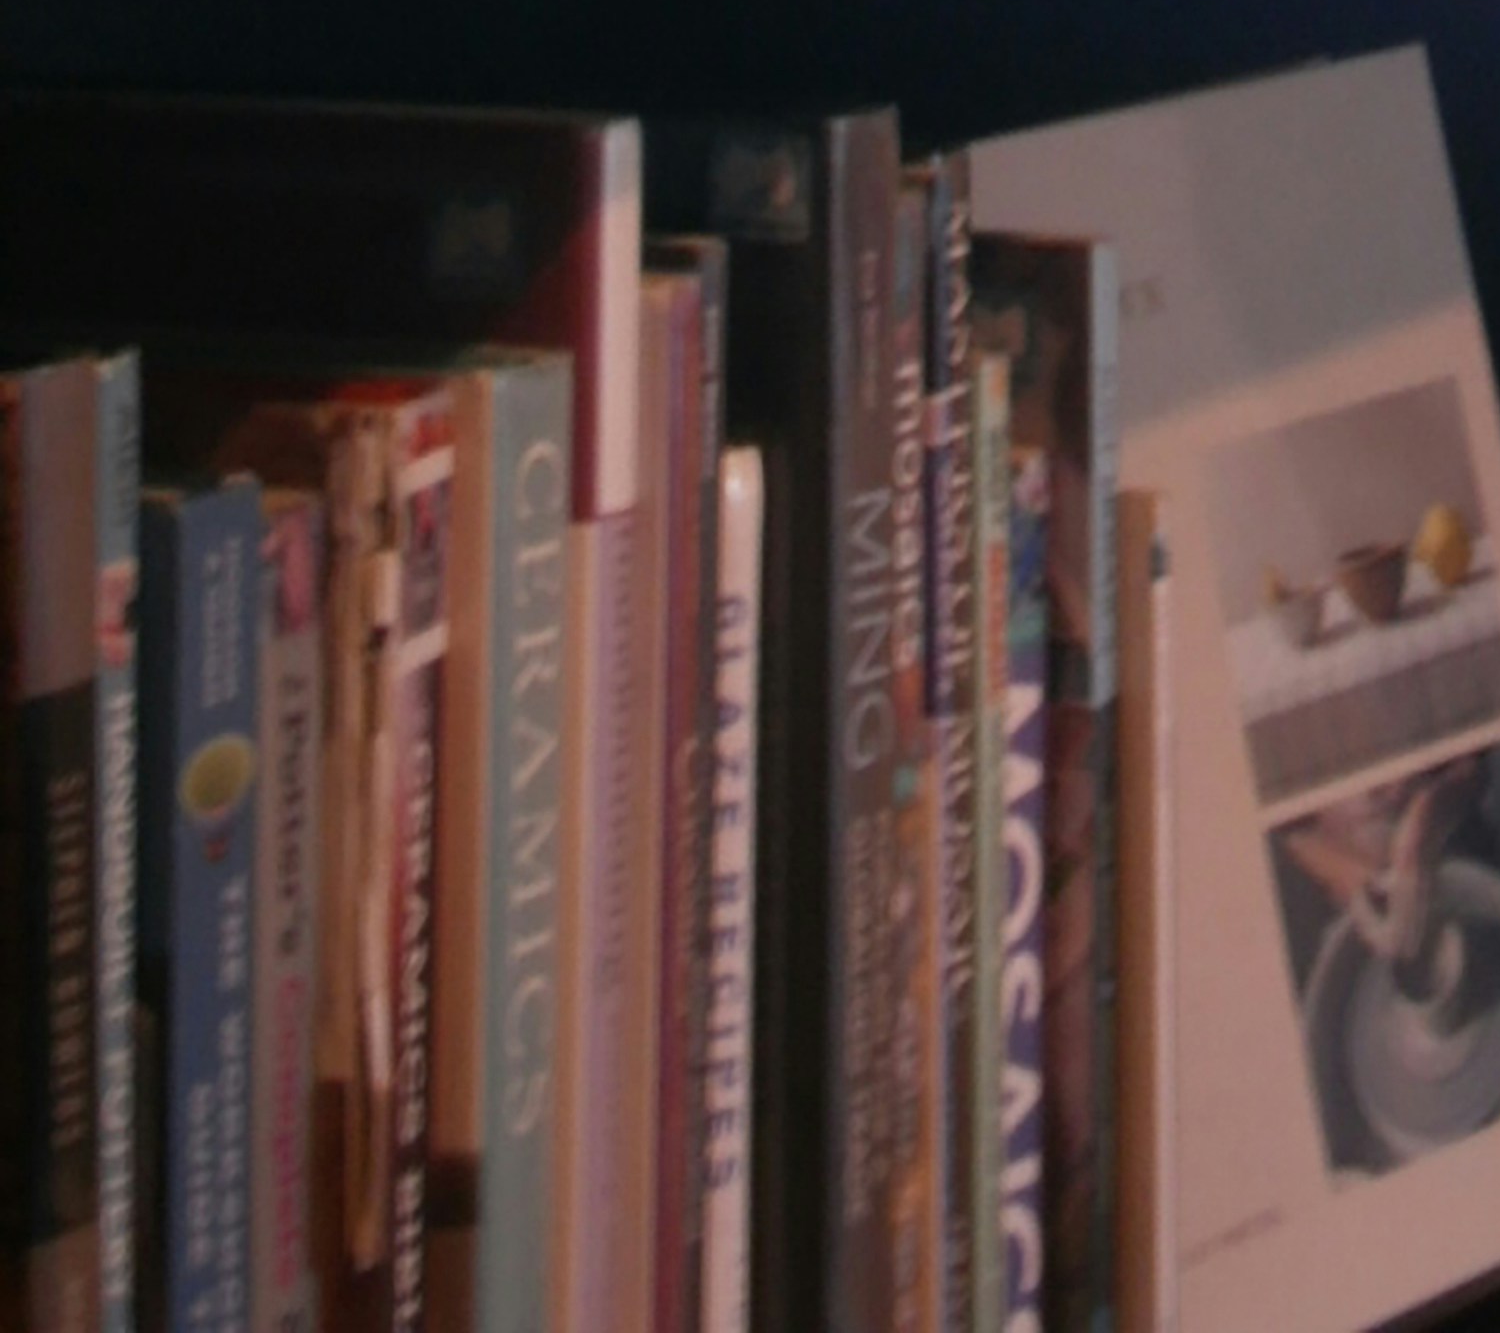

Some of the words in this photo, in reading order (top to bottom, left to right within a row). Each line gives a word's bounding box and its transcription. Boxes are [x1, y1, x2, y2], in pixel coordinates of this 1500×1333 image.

[843, 485, 896, 773] MING
[892, 364, 924, 673] mosaics
[503, 435, 566, 1137] CERAMICS
[711, 593, 750, 833] GLAZE
[702, 873, 744, 1189] RECIPES
